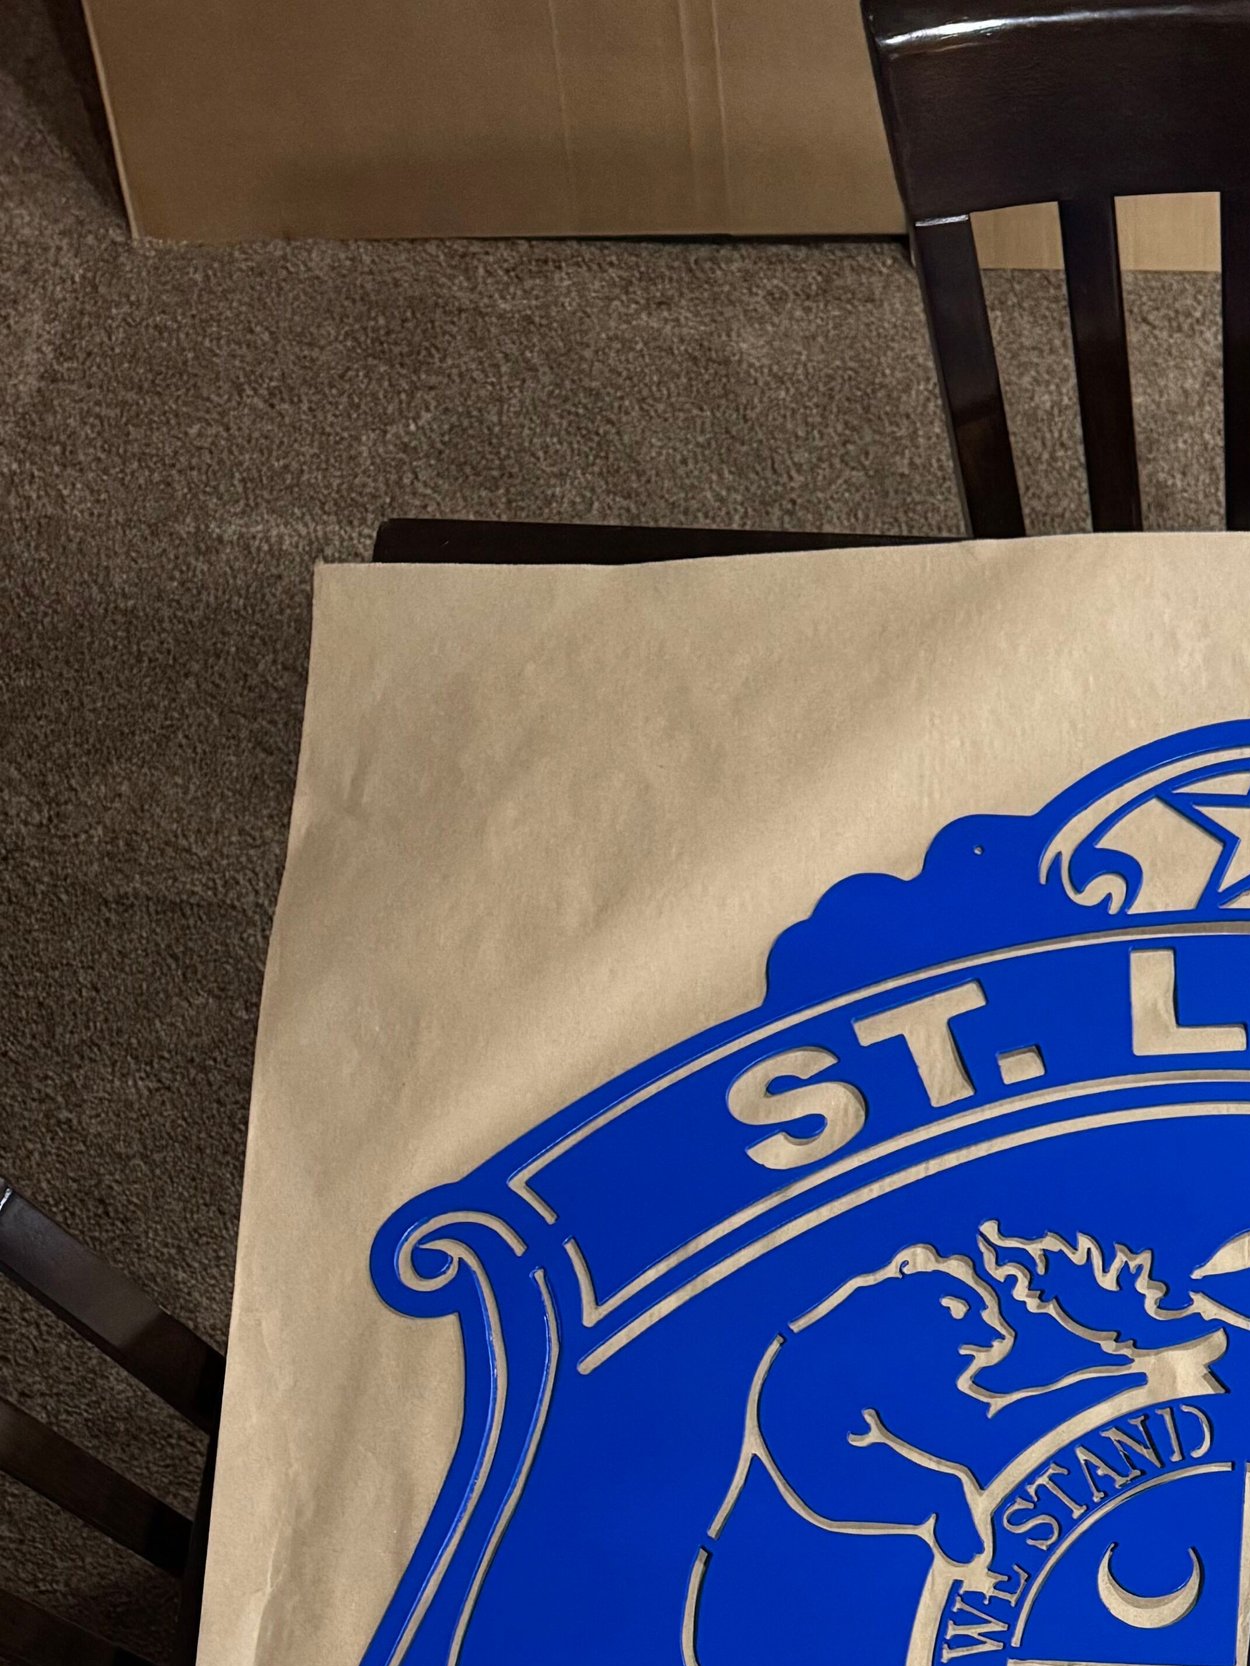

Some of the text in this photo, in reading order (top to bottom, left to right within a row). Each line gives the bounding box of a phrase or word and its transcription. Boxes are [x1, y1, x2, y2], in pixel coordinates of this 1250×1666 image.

[726, 978, 1045, 1171] ST.
[941, 1564, 1029, 1664] WE
[1003, 1404, 1213, 1550] STAND
